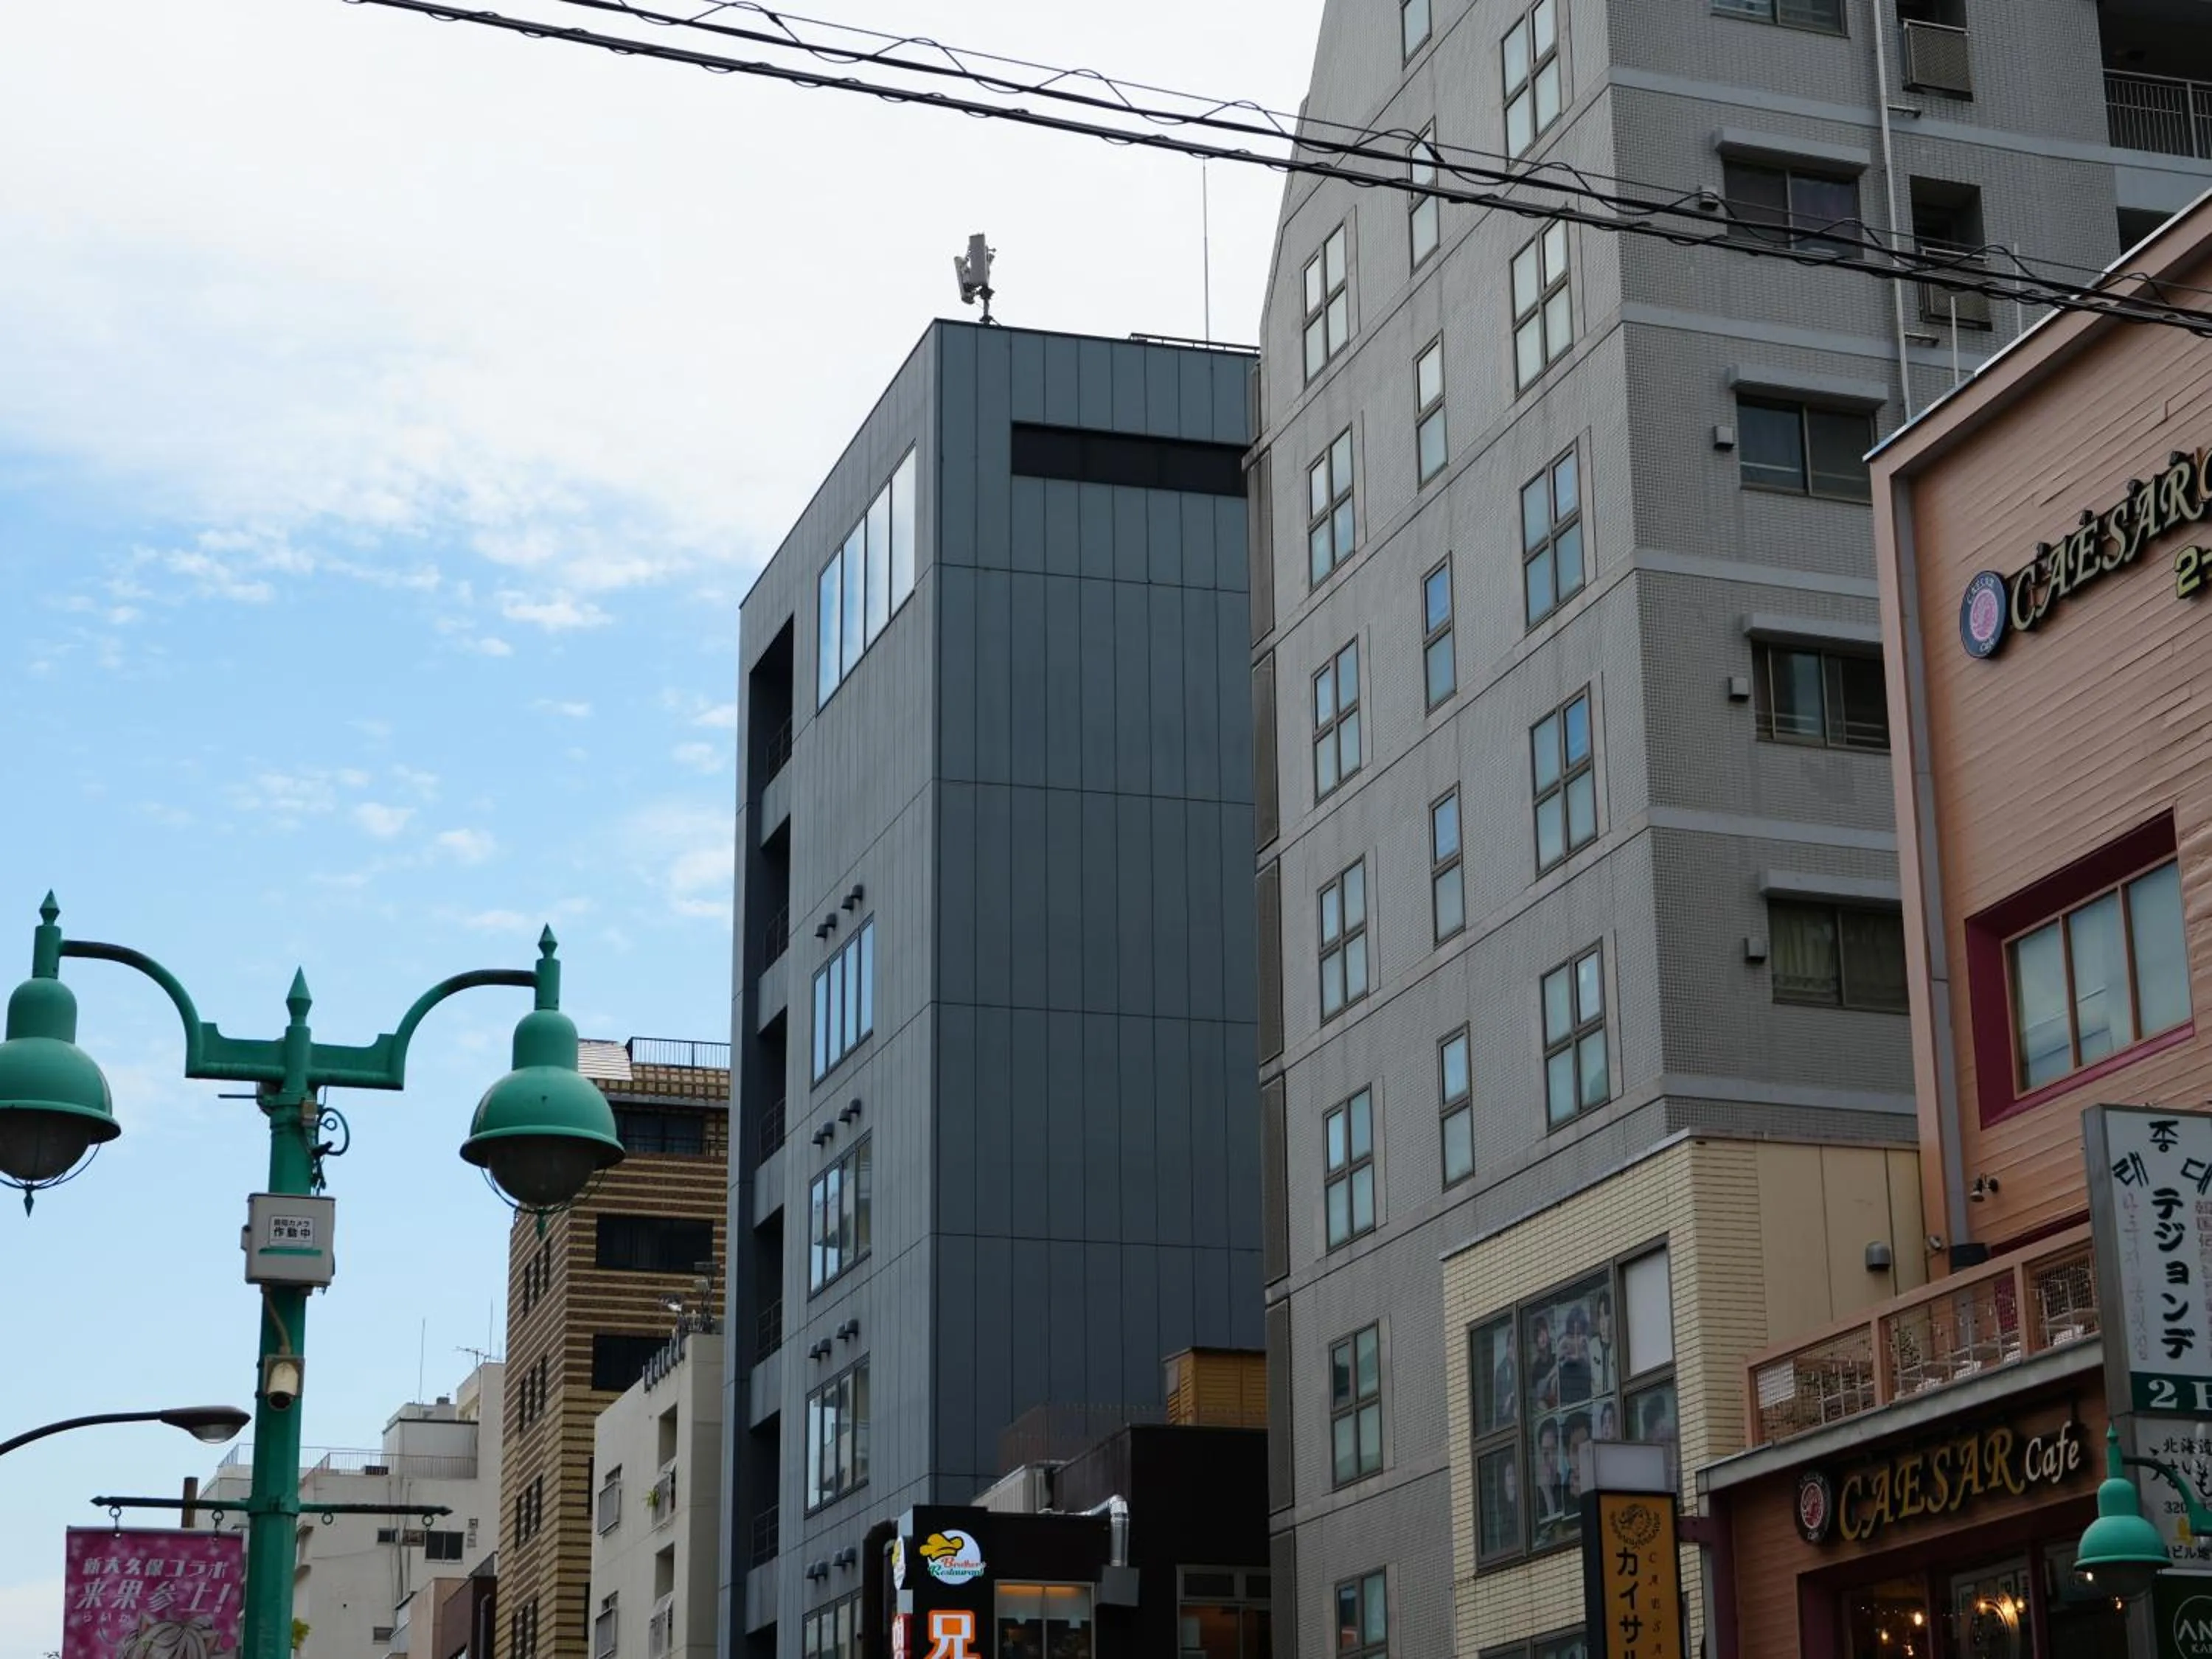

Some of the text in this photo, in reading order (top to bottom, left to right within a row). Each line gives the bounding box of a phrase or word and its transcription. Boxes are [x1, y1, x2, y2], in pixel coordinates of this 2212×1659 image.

[2011, 462, 2204, 632] CAESAR
[2152, 1187, 2194, 1360] テジョンデ
[1839, 1421, 2081, 1540] CAESAR Cafe
